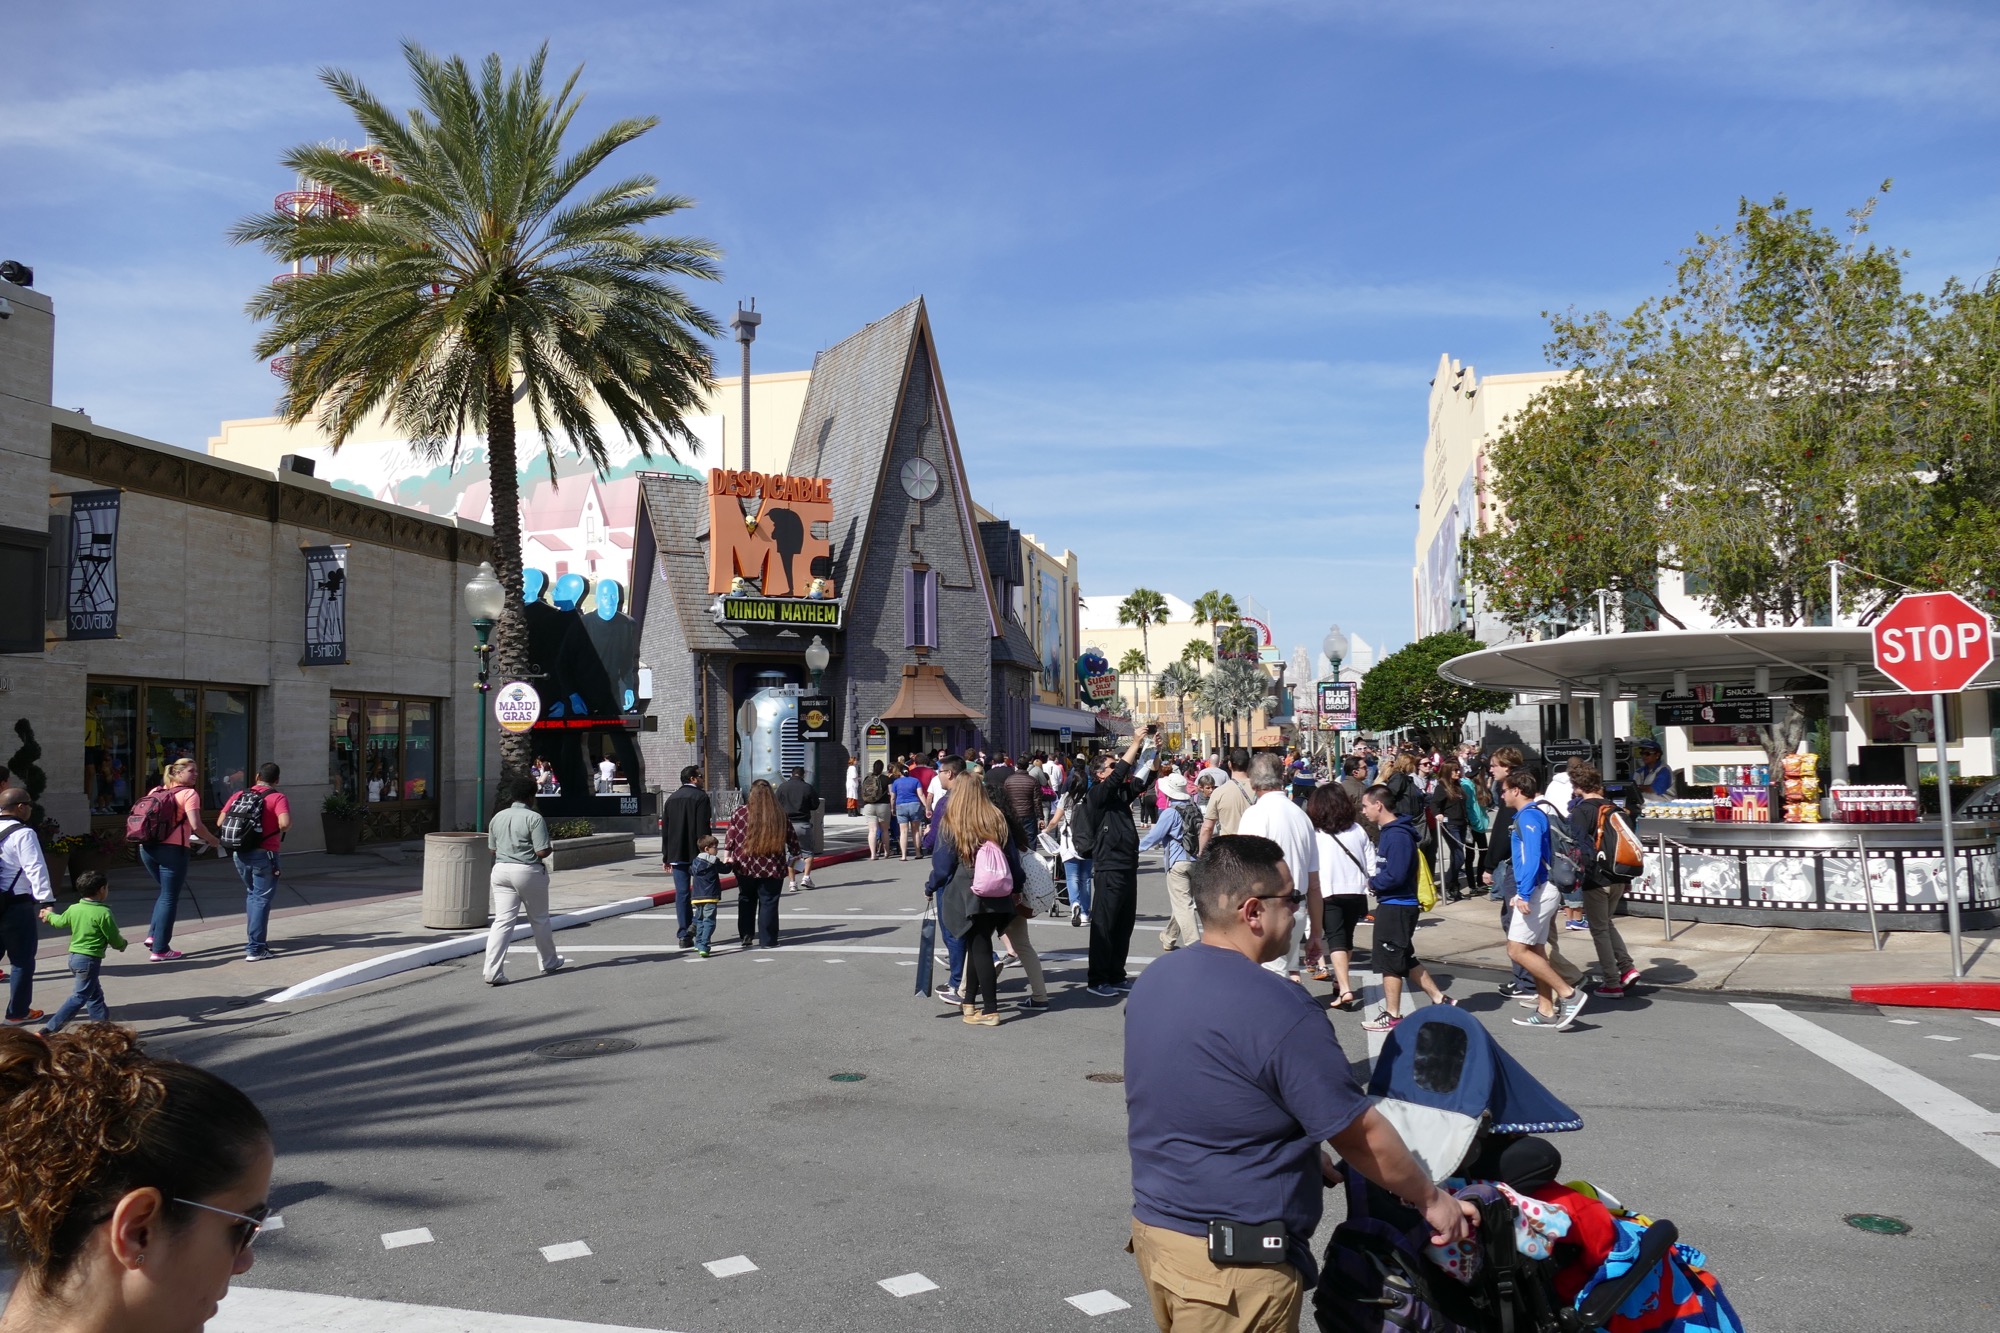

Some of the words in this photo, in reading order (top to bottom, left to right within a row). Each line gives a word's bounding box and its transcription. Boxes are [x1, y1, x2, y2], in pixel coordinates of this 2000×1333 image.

[712, 469, 832, 502] DESPICABLE
[709, 494, 835, 598] ME
[726, 601, 775, 621] MINION
[781, 603, 836, 623] MAYHEM
[71, 613, 113, 630] SOUVENIRS
[1882, 622, 1981, 664] STOP
[309, 644, 341, 658] T-SHIRTS
[1087, 674, 1116, 686] SUPER
[1095, 682, 1111, 690] SILLY
[1091, 689, 1116, 698] STUFF
[1726, 688, 1757, 696] SNACKS
[499, 701, 536, 710] MARDI
[503, 712, 532, 720] GRAS
